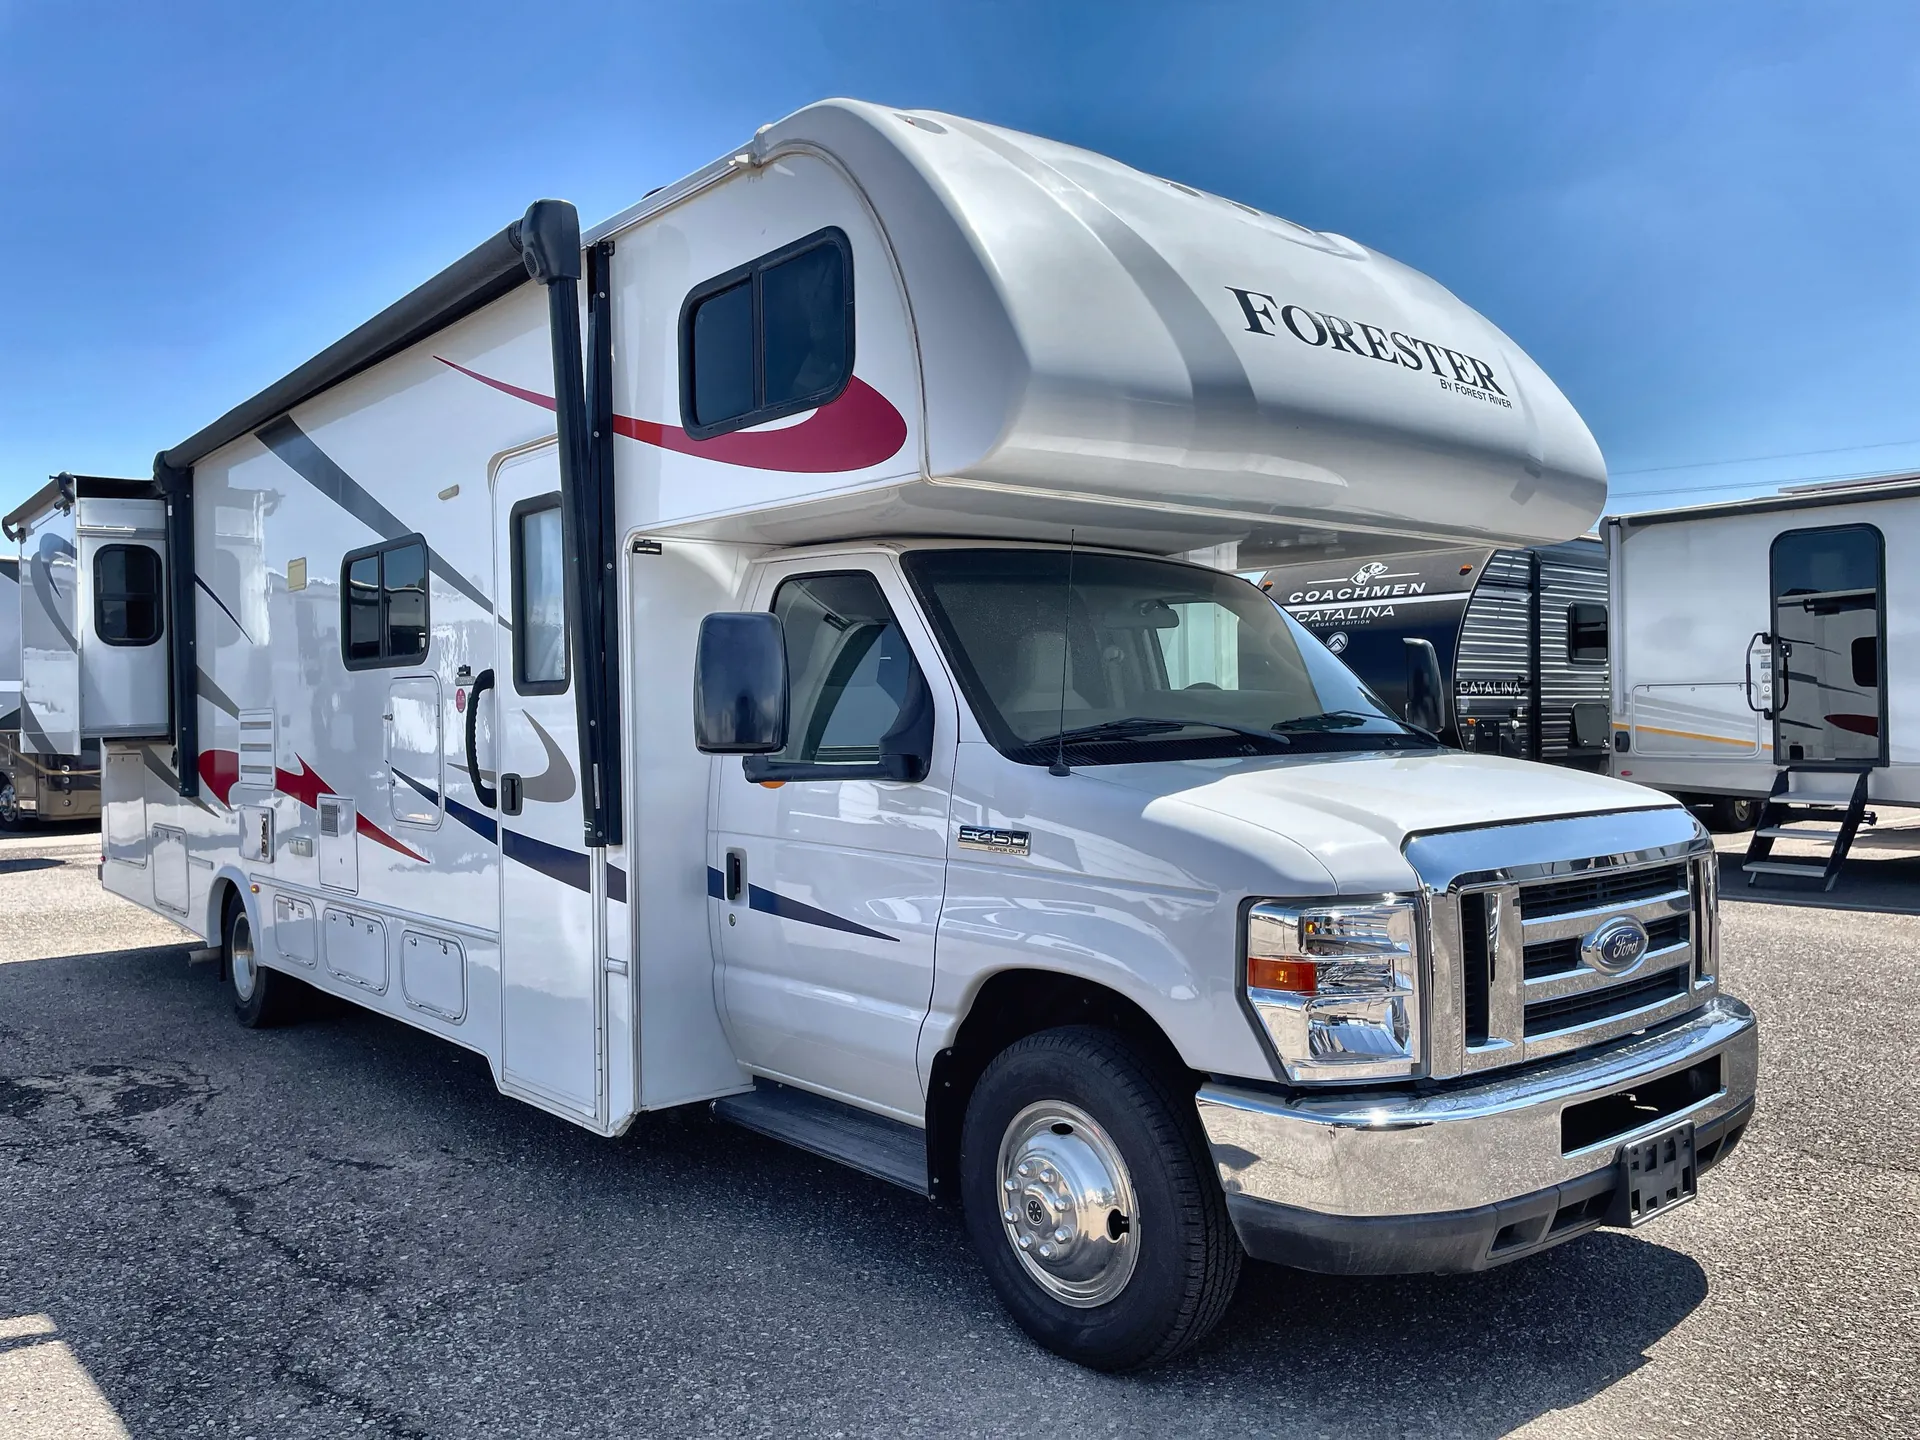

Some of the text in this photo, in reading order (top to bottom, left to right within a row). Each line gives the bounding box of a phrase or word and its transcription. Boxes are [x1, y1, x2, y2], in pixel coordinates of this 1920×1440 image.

[1224, 286, 1508, 397] FORESTER
[1439, 378, 1513, 410] BY FOREST RIVER
[1288, 582, 1426, 604] COACHMEN
[1296, 605, 1395, 623] CATALINA
[1459, 681, 1521, 695] CATALINA
[1612, 933, 1639, 959] Ford
